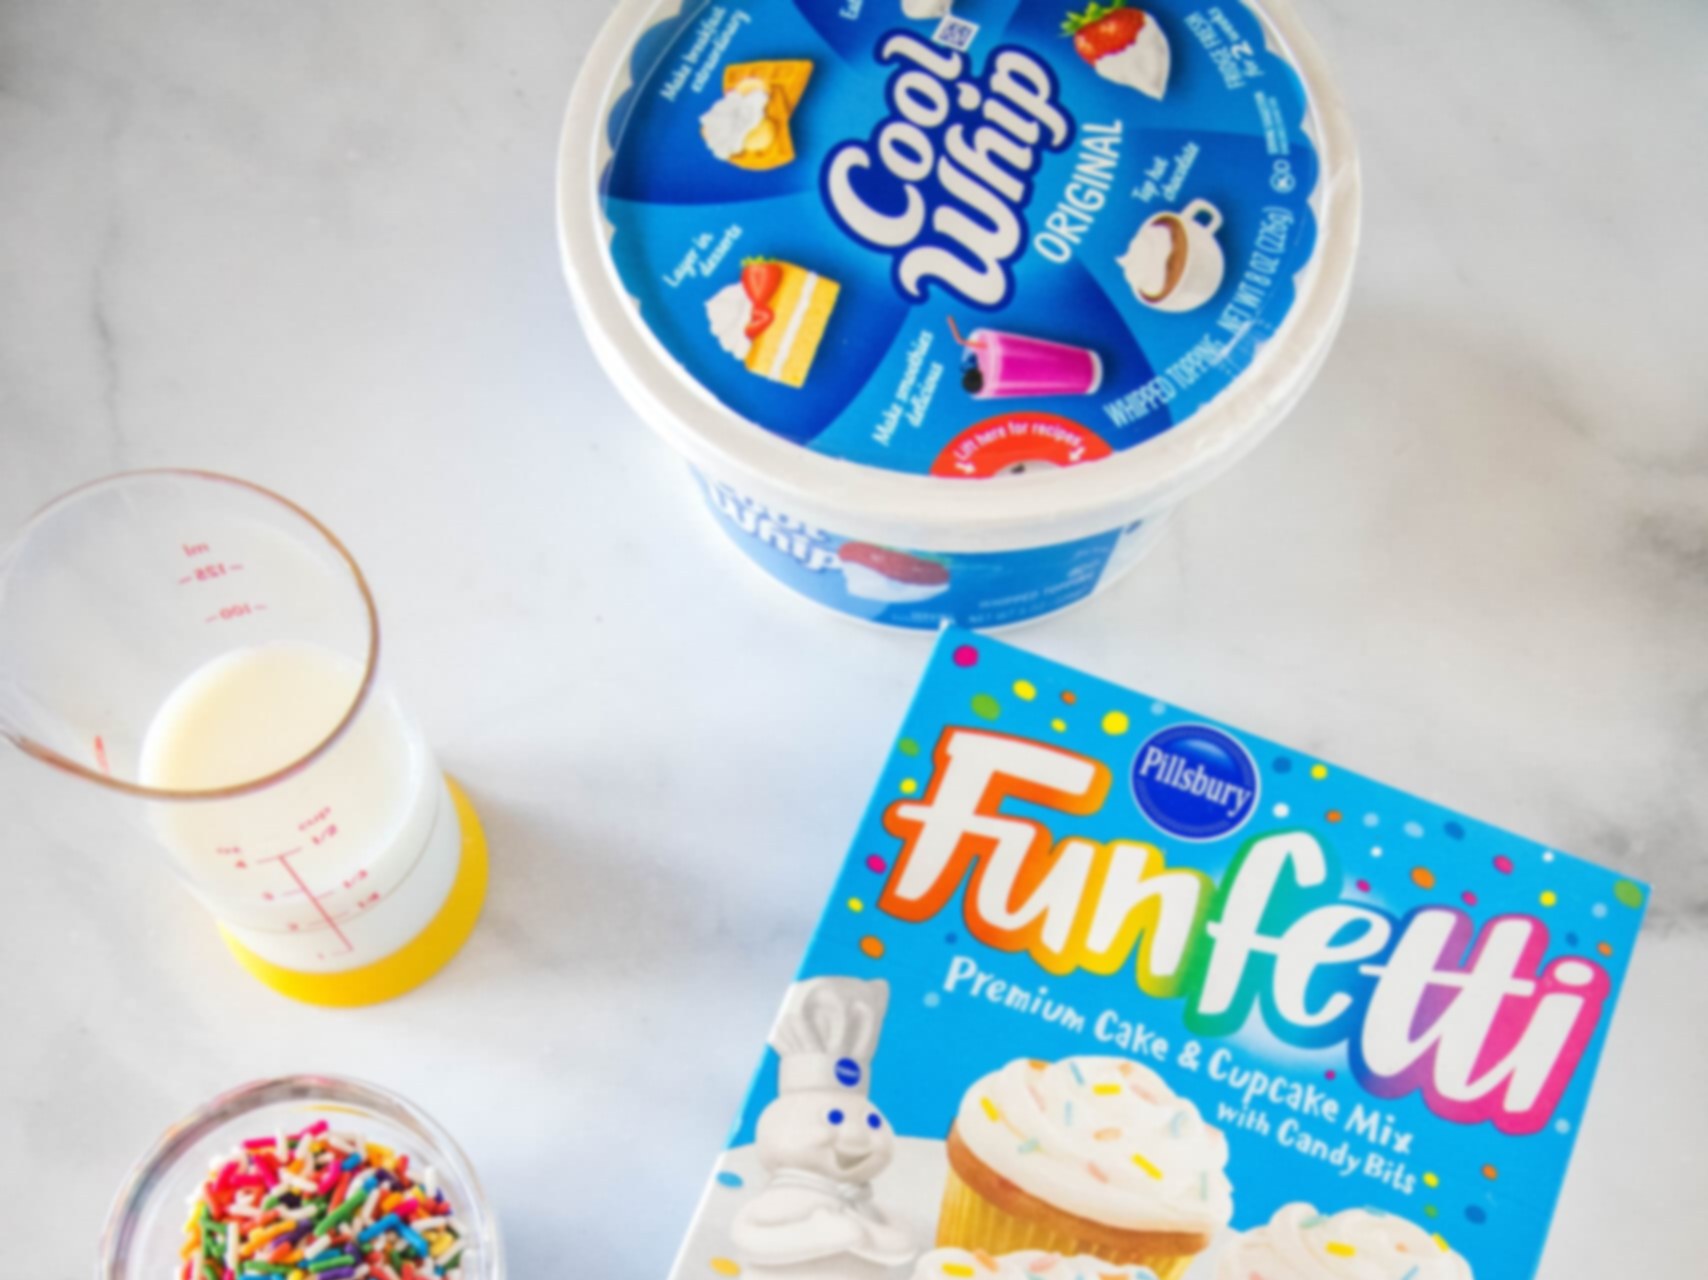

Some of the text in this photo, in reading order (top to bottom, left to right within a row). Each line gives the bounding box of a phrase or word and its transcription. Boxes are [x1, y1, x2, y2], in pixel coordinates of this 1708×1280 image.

[660, 63, 692, 101] Make
[1230, 39, 1254, 61] 2
[826, 34, 963, 249] Cool
[897, 50, 1068, 305] Whip
[1033, 118, 1123, 264] ORIGINAL
[698, 223, 743, 277] desserts
[1102, 375, 1177, 429] WHIPPED
[1249, 250, 1281, 276] OZ
[871, 402, 903, 447] Make
[1138, 745, 1253, 818] Pillsbury
[884, 727, 1606, 1128] Funfetti
[942, 955, 1414, 1155] Premium Cake & Cupcake Mix
[1216, 1102, 1417, 1196] with Candy Bits
